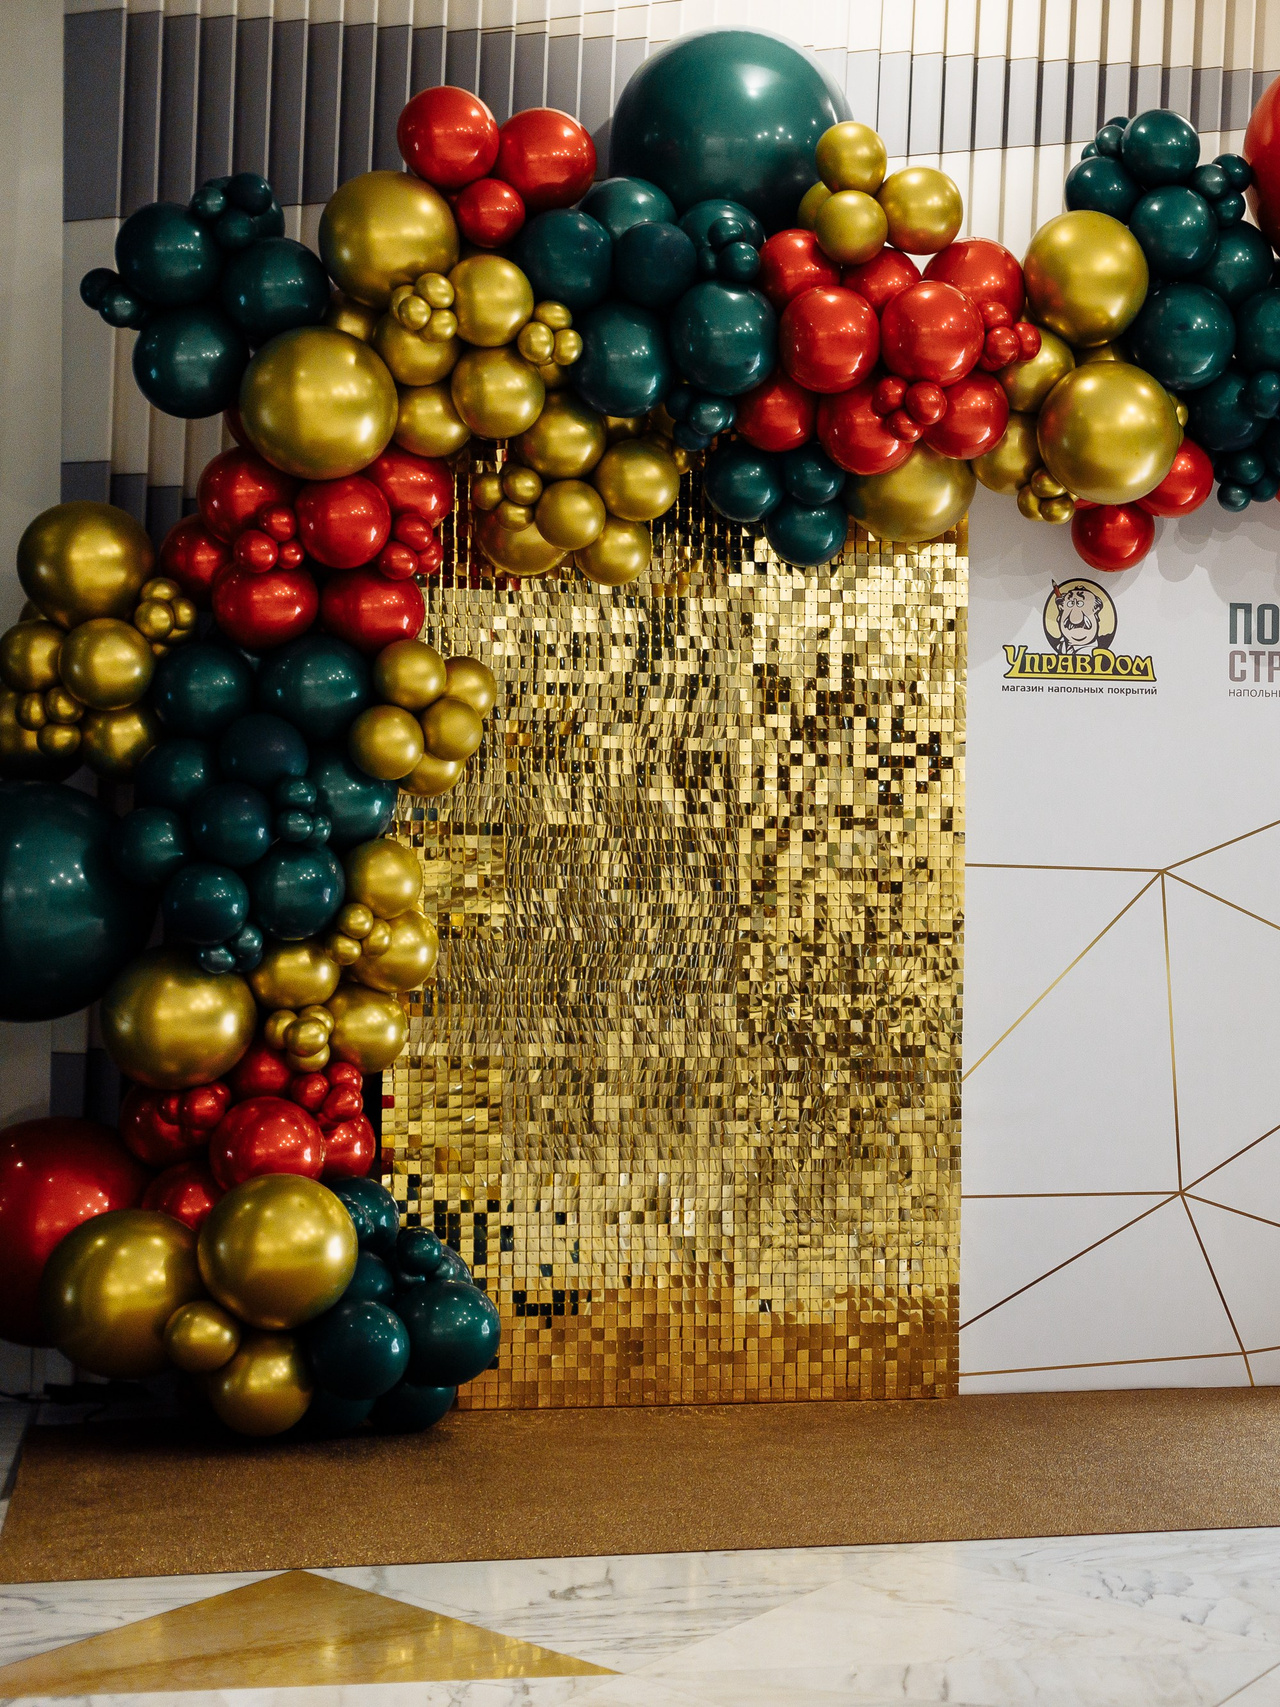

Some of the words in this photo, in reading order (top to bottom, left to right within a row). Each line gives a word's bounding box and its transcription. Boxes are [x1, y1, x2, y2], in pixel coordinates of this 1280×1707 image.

[1001, 685, 1044, 693] магазин
[1048, 685, 1104, 694] напольных
[1107, 686, 1158, 697] покрытий
